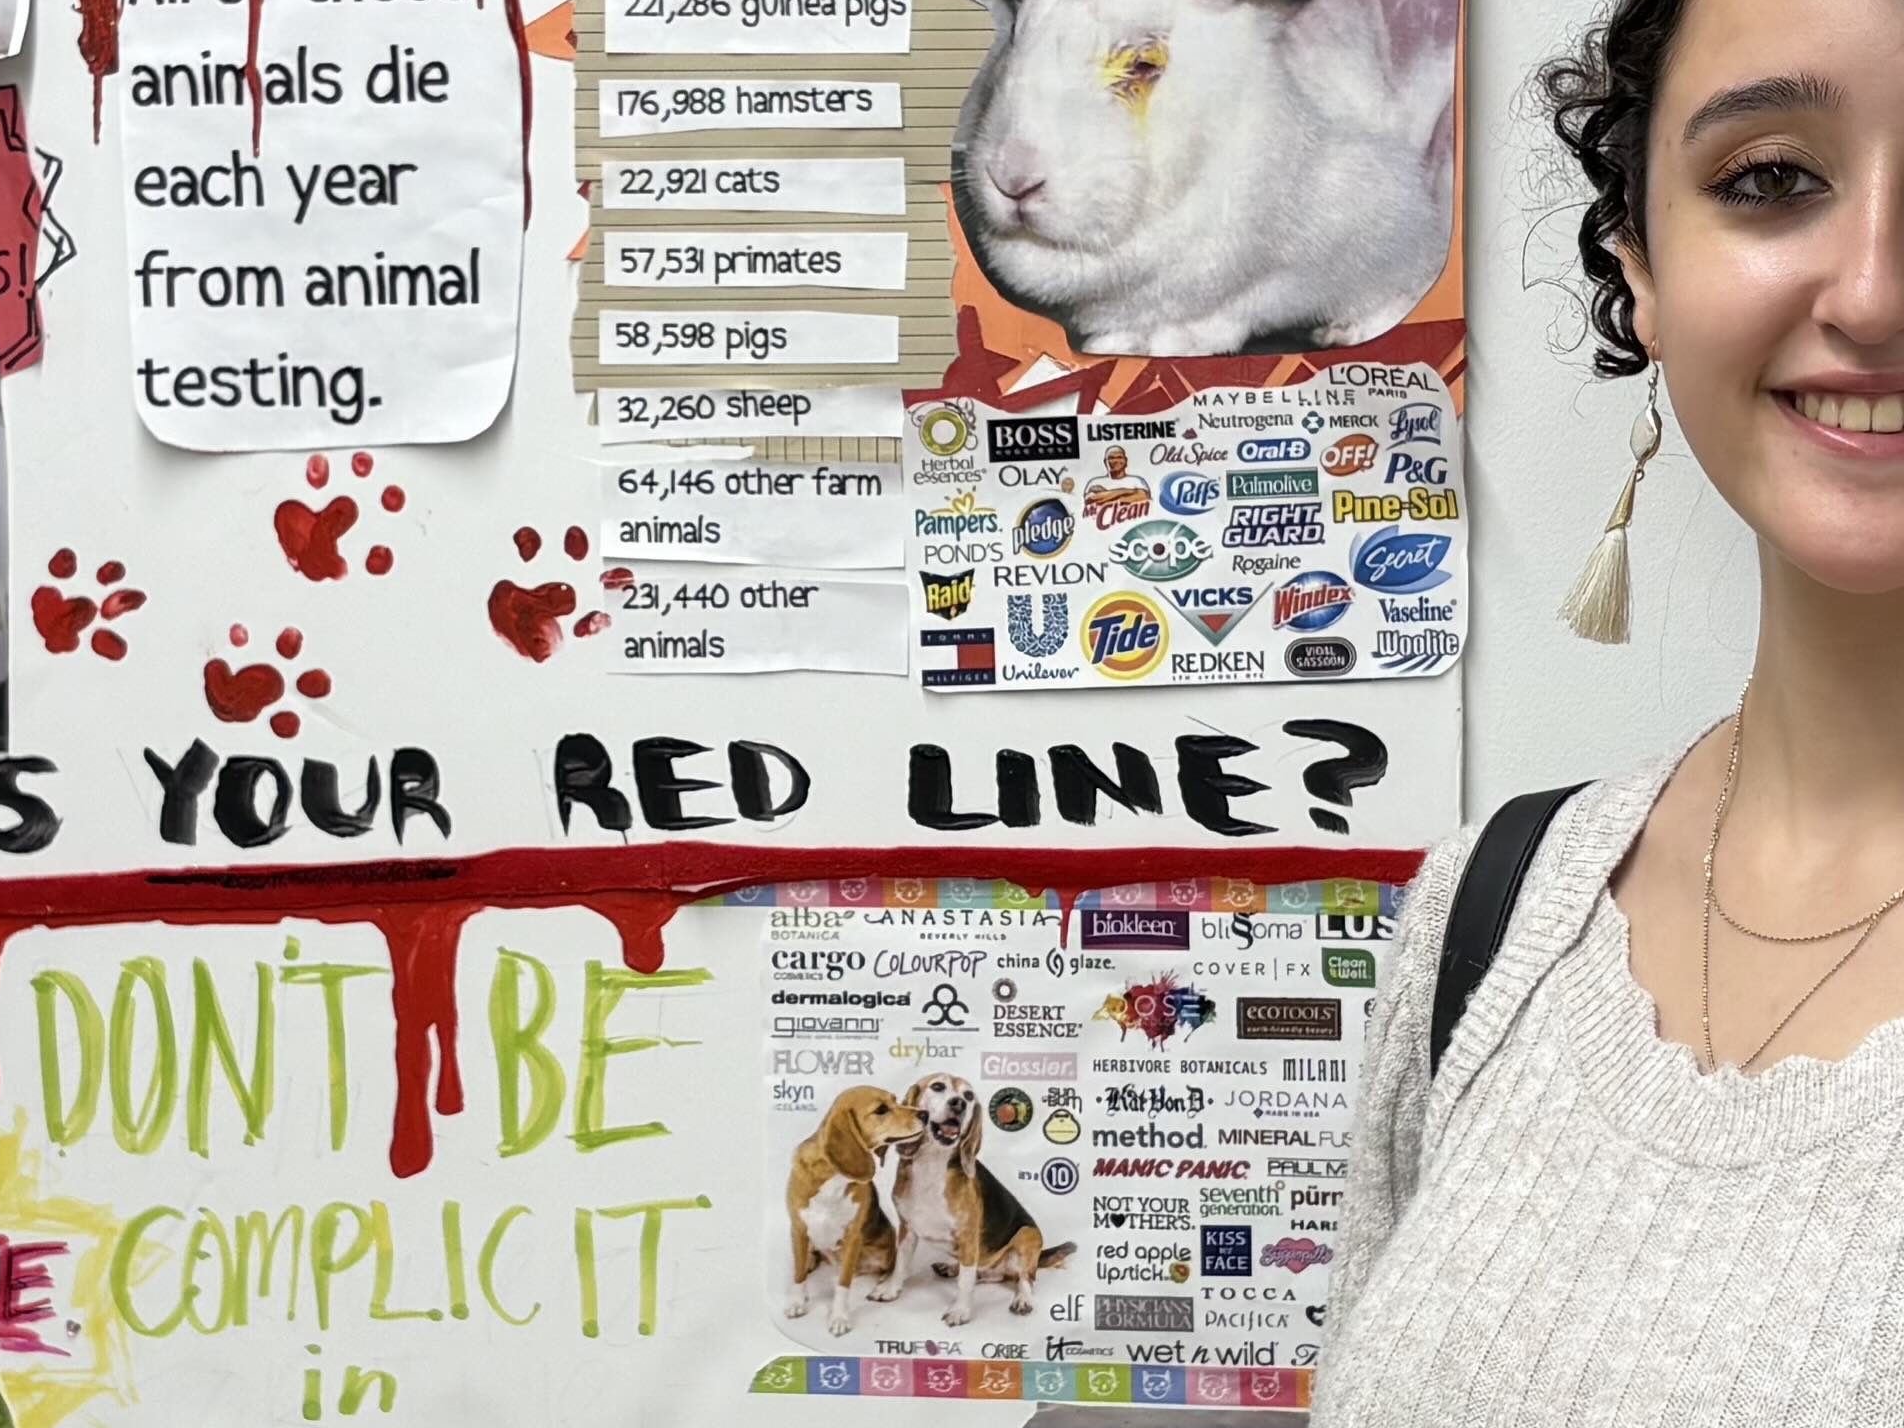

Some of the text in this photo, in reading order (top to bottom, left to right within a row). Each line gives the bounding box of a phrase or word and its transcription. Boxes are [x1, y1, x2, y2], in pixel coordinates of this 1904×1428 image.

[132, 44, 449, 106] animals die
[618, 87, 872, 123] 176,988 hamsters
[135, 150, 418, 223] each year
[620, 168, 780, 201] 22,921 cats
[620, 246, 841, 283] 57,531 primates
[135, 247, 479, 307] from animal
[615, 322, 787, 359] 58,598 pigs
[137, 353, 382, 424] testing.
[1368, 388, 1407, 398] PARIS
[617, 391, 811, 428] 32,260 sheep
[1329, 415, 1378, 428] MERCK
[1087, 422, 1177, 442] LISTERINE
[1199, 413, 1293, 431] Neutrogena
[996, 424, 1072, 448] BOSS
[922, 457, 974, 470] Herbal
[1150, 442, 1227, 466] Old Spice
[913, 470, 981, 485] essences
[1384, 453, 1448, 484] P&G
[618, 467, 882, 501] 64,146 other farm
[1178, 479, 1220, 507] Puffs
[1231, 474, 1312, 495] Palmolive
[1231, 504, 1322, 526] RIGHT
[620, 514, 721, 544] animals
[1222, 523, 1324, 547] GUARD
[994, 564, 1106, 586] REVLON
[1232, 553, 1300, 575] Rogaine
[622, 580, 819, 616] 231,440 other
[927, 584, 972, 609] Raid
[1172, 586, 1253, 607] VICKS
[1272, 585, 1355, 629] Windex
[1378, 598, 1453, 623] Vaseline
[624, 629, 725, 659] animals
[1089, 611, 1160, 665] Tide
[1377, 632, 1458, 656] Woolite
[1172, 651, 1264, 673] REDKEN
[144, 737, 454, 849] YOUR
[555, 733, 812, 839] RED
[908, 717, 1390, 837] LINE?
[864, 910, 1062, 925] ANASTASIA
[771, 950, 865, 981] cargo
[997, 954, 1039, 968] china
[1193, 962, 1310, 976] COVER FX
[771, 992, 911, 1008] dermalogica
[993, 1005, 1065, 1020] DESERT
[993, 1024, 1079, 1037] ESSENCE
[30, 936, 716, 1159] DON'T BE
[890, 1037, 962, 1067] drybar
[774, 1050, 874, 1075] FLOWER
[1093, 1060, 1267, 1074] HERBIVORE BOTANICALS
[1283, 1059, 1346, 1082] MILANI
[773, 1080, 814, 1101] skyn
[1225, 1092, 1348, 1108] JORDANA
[1219, 1130, 1316, 1146] MINERAL
[1093, 1158, 1251, 1179] MANIC PANIC
[1093, 1197, 1189, 1213] NOT YOUR
[1200, 1184, 1279, 1204] seventh
[1206, 1232, 1245, 1246] KISS
[1096, 1242, 1191, 1264] red apple
[1205, 1257, 1247, 1270] FACE
[1202, 1288, 1296, 1301] TOCCA
[1050, 1294, 1085, 1321] elf
[1127, 1341, 1185, 1363] wet
[1215, 1342, 1275, 1366] wild
[303, 1343, 397, 1421] in
